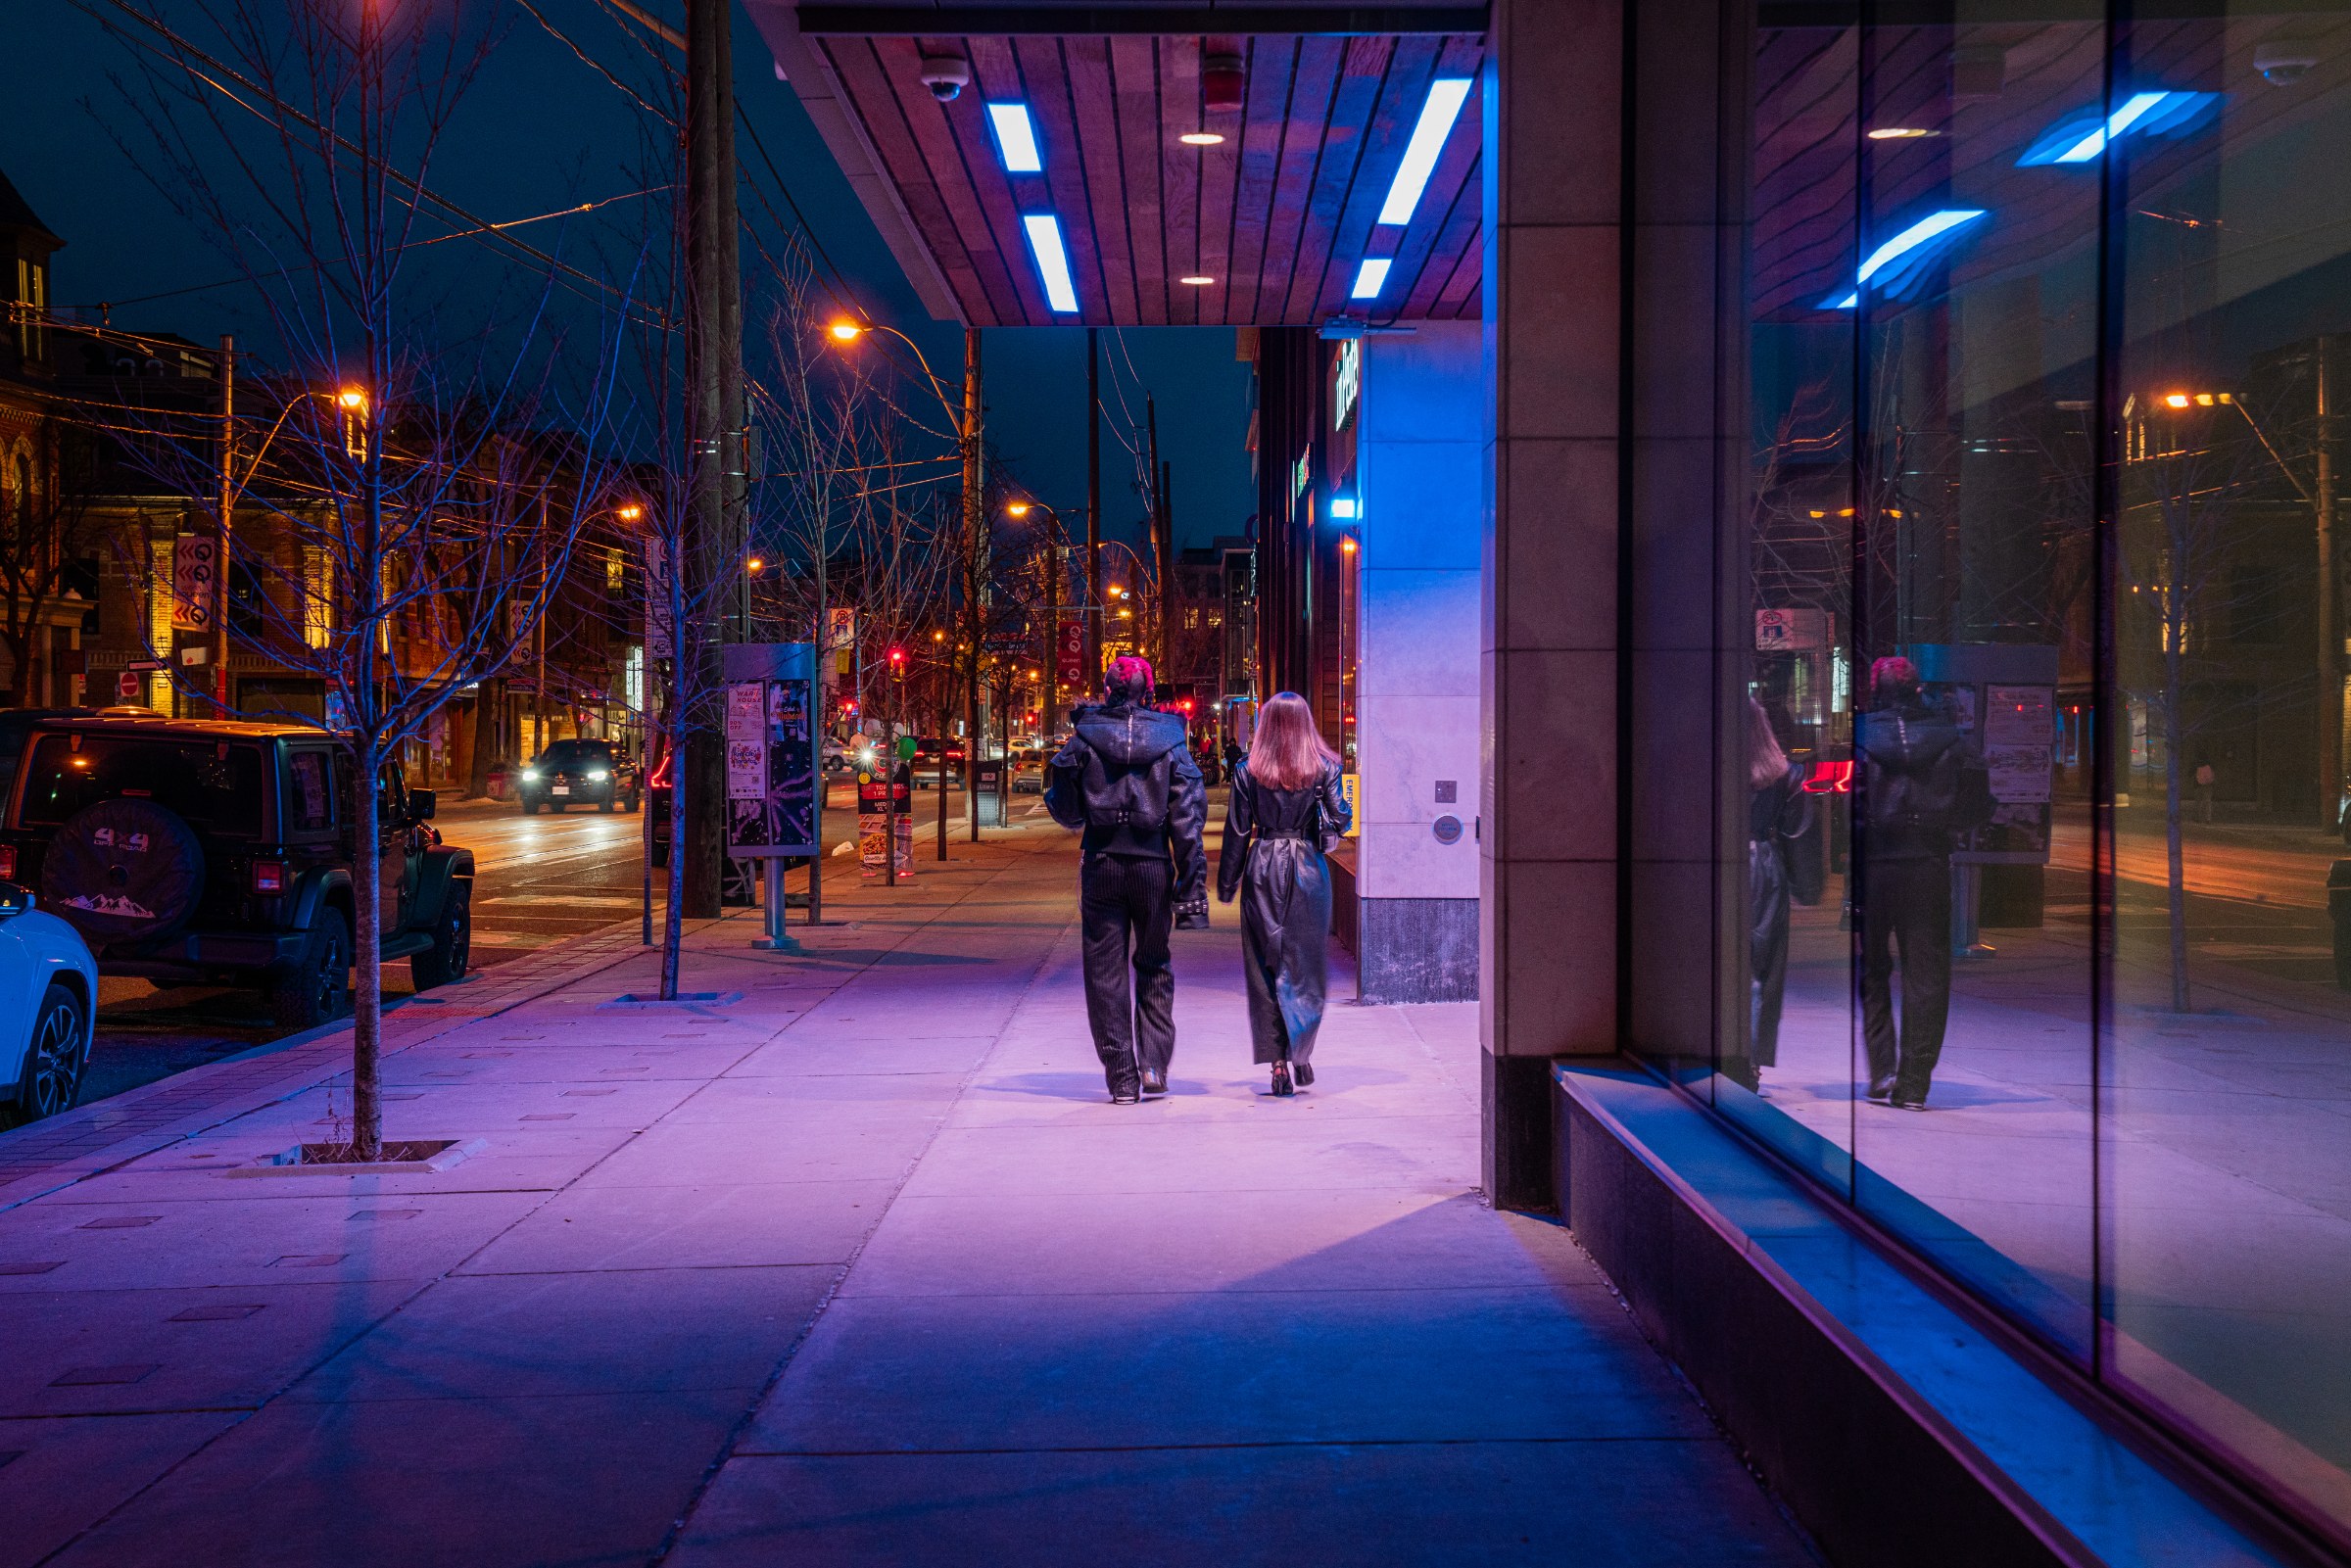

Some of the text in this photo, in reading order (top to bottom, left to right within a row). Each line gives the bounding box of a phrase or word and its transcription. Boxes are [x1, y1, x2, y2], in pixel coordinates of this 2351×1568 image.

[195, 544, 213, 562] Q
[194, 565, 211, 584] Q
[191, 606, 208, 625] Q
[1070, 625, 1081, 639] Q
[1069, 640, 1080, 653] Q
[1069, 668, 1080, 681] Q
